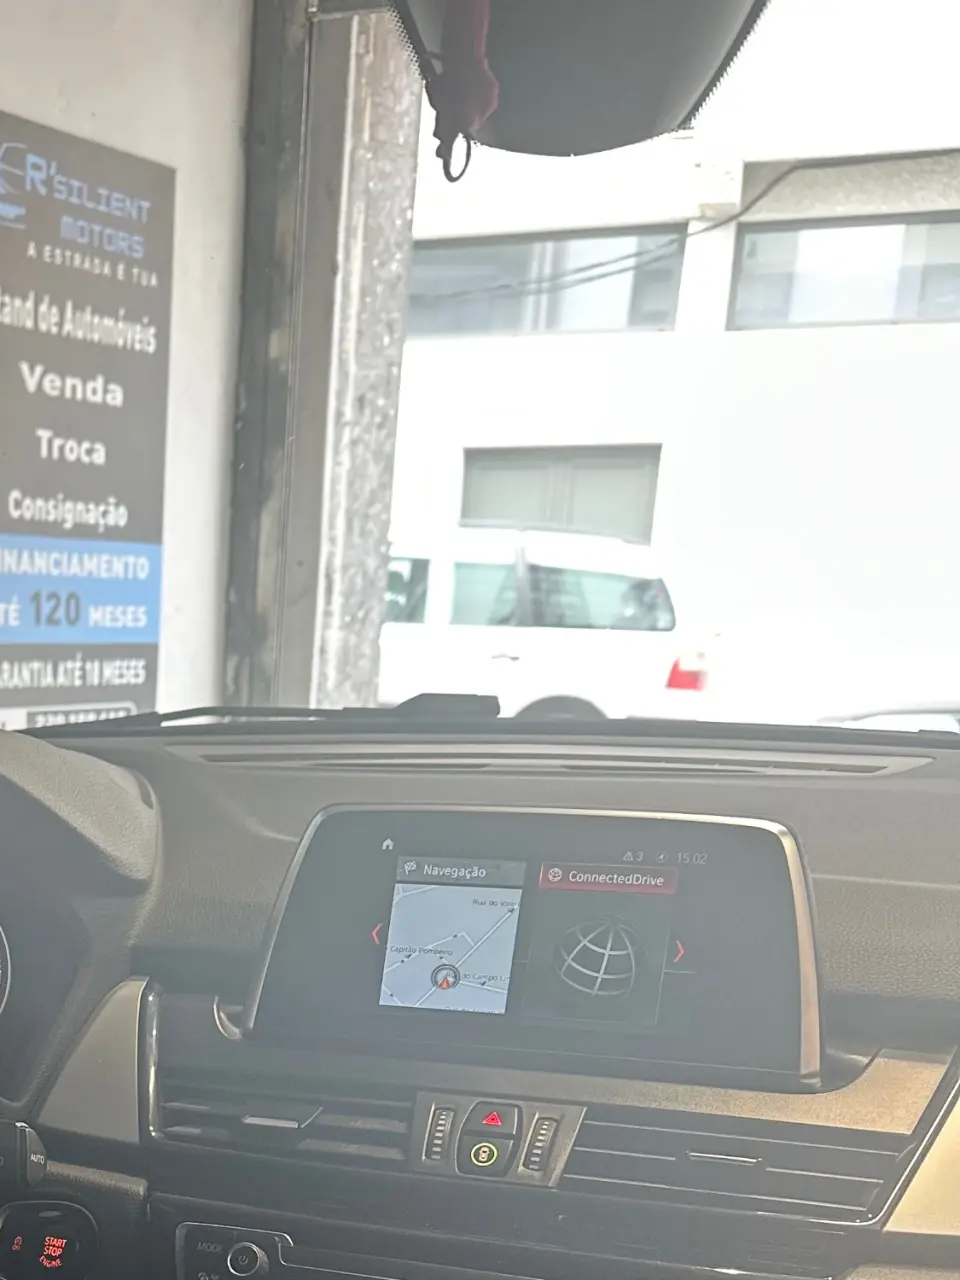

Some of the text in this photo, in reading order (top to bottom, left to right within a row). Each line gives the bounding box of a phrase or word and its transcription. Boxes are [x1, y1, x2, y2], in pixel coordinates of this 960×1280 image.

[60, 214, 144, 259] MOTORS
[27, 240, 37, 260] A
[43, 244, 112, 277] ESTRADA
[131, 265, 158, 288] TUA
[39, 295, 59, 335] de
[61, 300, 157, 354] Automóveis
[19, 361, 124, 406] Venda
[36, 428, 107, 465] Troca
[8, 489, 129, 533] Consignação
[30, 591, 81, 626] 120
[88, 604, 148, 628] MESES
[56, 652, 83, 688] ATÉ
[102, 658, 147, 686] MESES
[423, 863, 486, 879] Navegação
[569, 871, 664, 886] ConnectedDrive
[30, 1153, 45, 1164] AUTO
[43, 1246, 63, 1257] STOP
[44, 1236, 67, 1248] START
[197, 1242, 224, 1253] MODE
[39, 1255, 63, 1268] ENGINE
